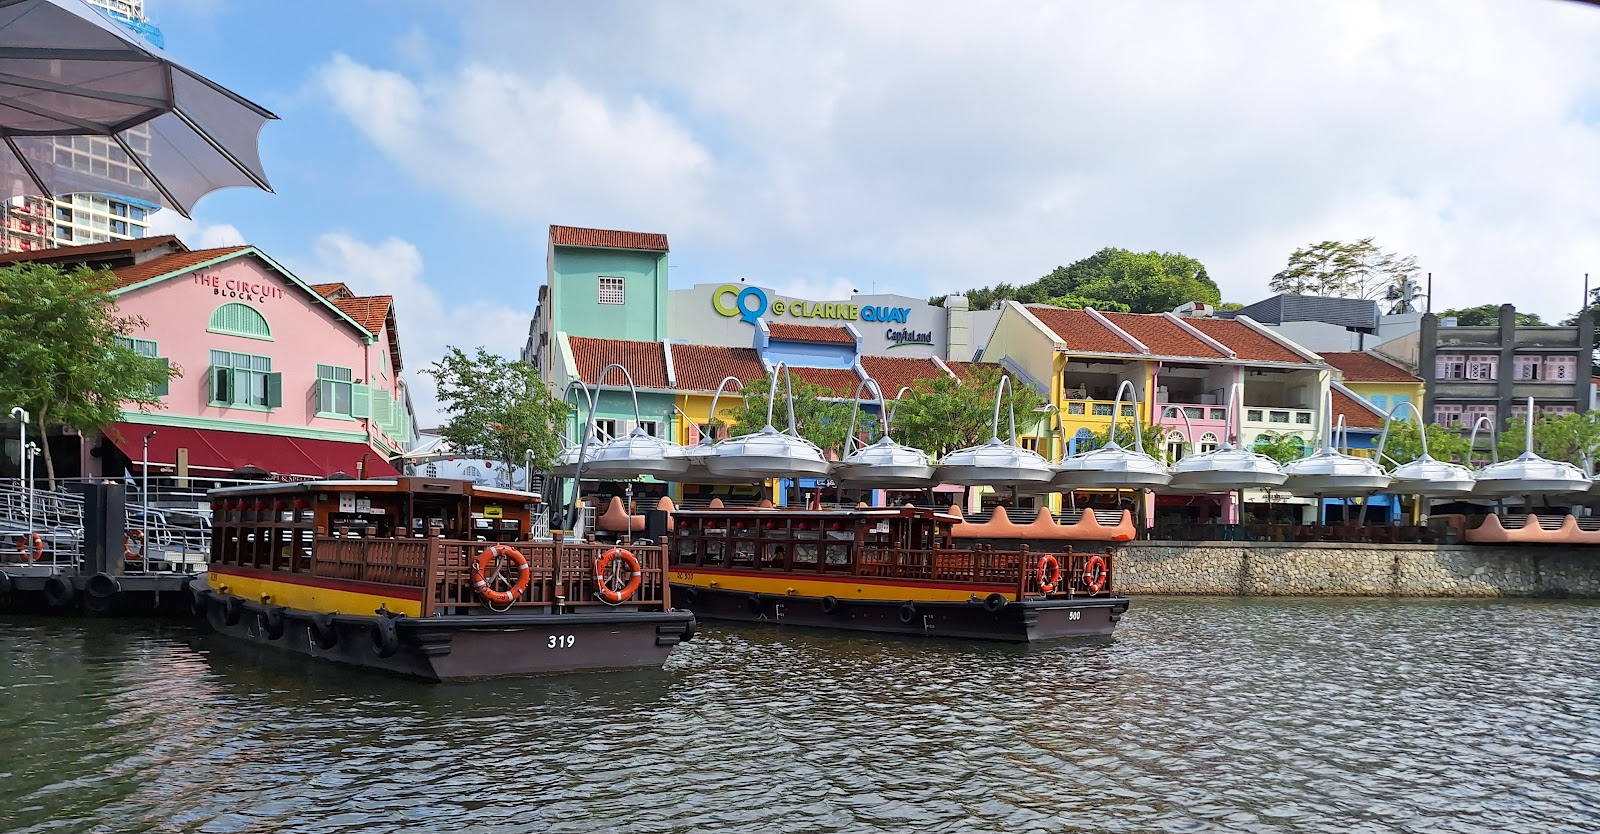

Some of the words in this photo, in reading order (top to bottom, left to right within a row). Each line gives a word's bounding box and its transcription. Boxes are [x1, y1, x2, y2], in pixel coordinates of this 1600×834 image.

[193, 272, 219, 287] THE
[226, 279, 284, 299] CIRCUIT
[213, 288, 253, 301] BLOCK
[713, 285, 768, 326] CQ
[771, 300, 786, 316] @
[790, 300, 858, 321] CLARKE
[861, 305, 911, 323] QUAY
[886, 327, 932, 343] CapitaLand
[1068, 611, 1081, 621] 500
[547, 635, 576, 649] 319
